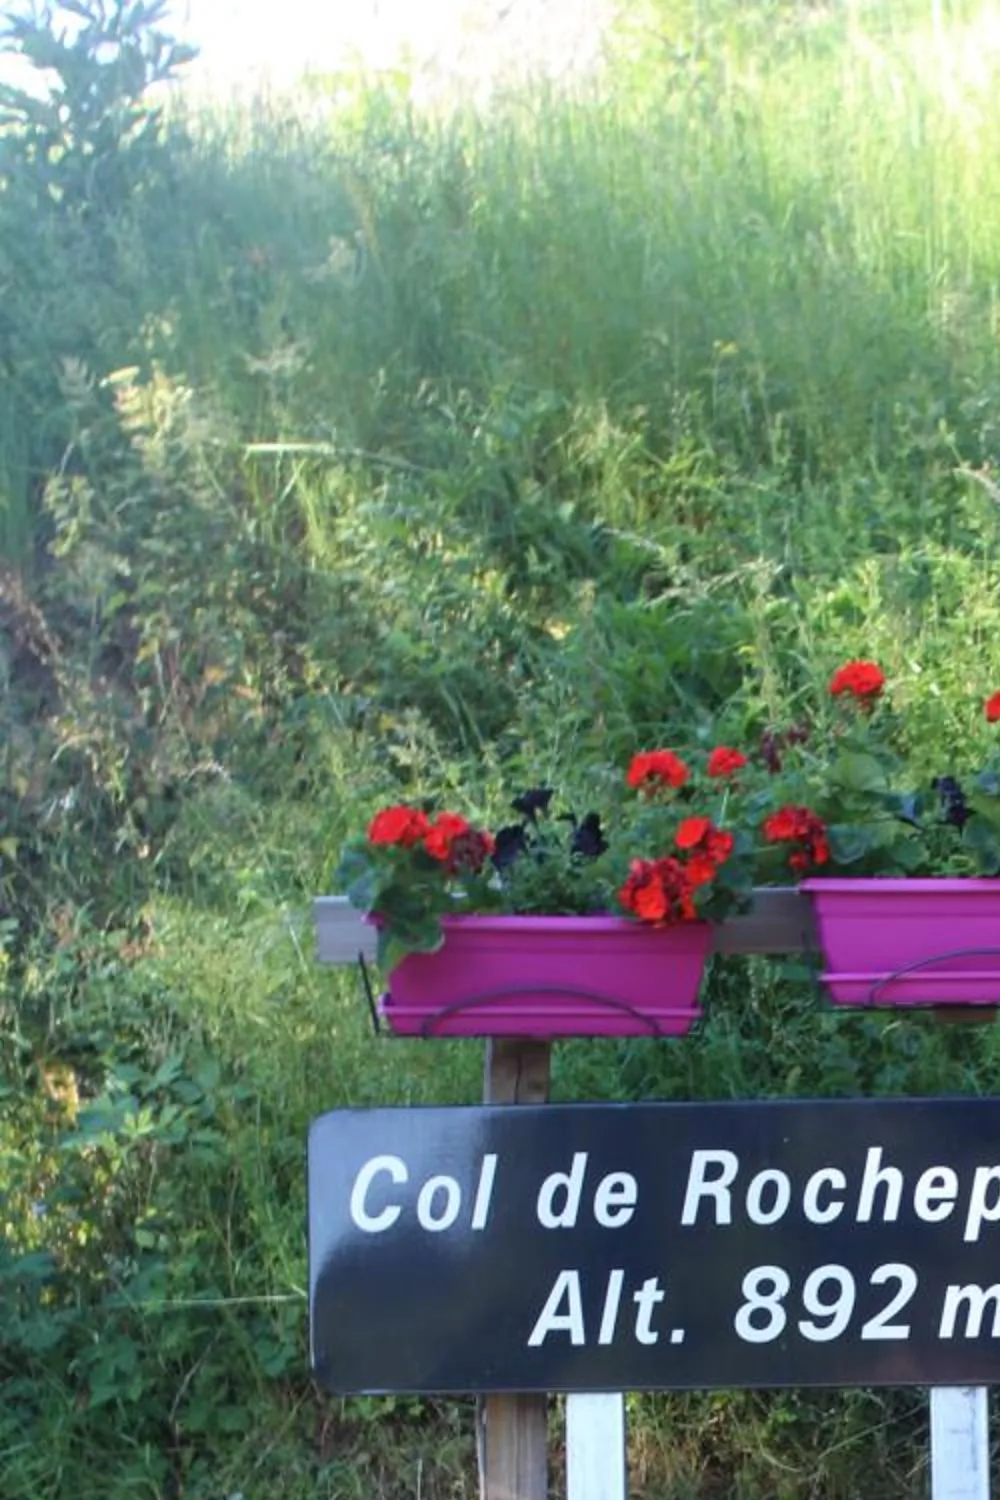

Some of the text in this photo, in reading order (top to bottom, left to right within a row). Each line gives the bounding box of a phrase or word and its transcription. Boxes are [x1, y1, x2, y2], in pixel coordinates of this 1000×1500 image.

[349, 1153, 498, 1233] Col
[536, 1151, 639, 1229] de
[527, 1268, 686, 1347] Alt.
[733, 1262, 919, 1343] 892
